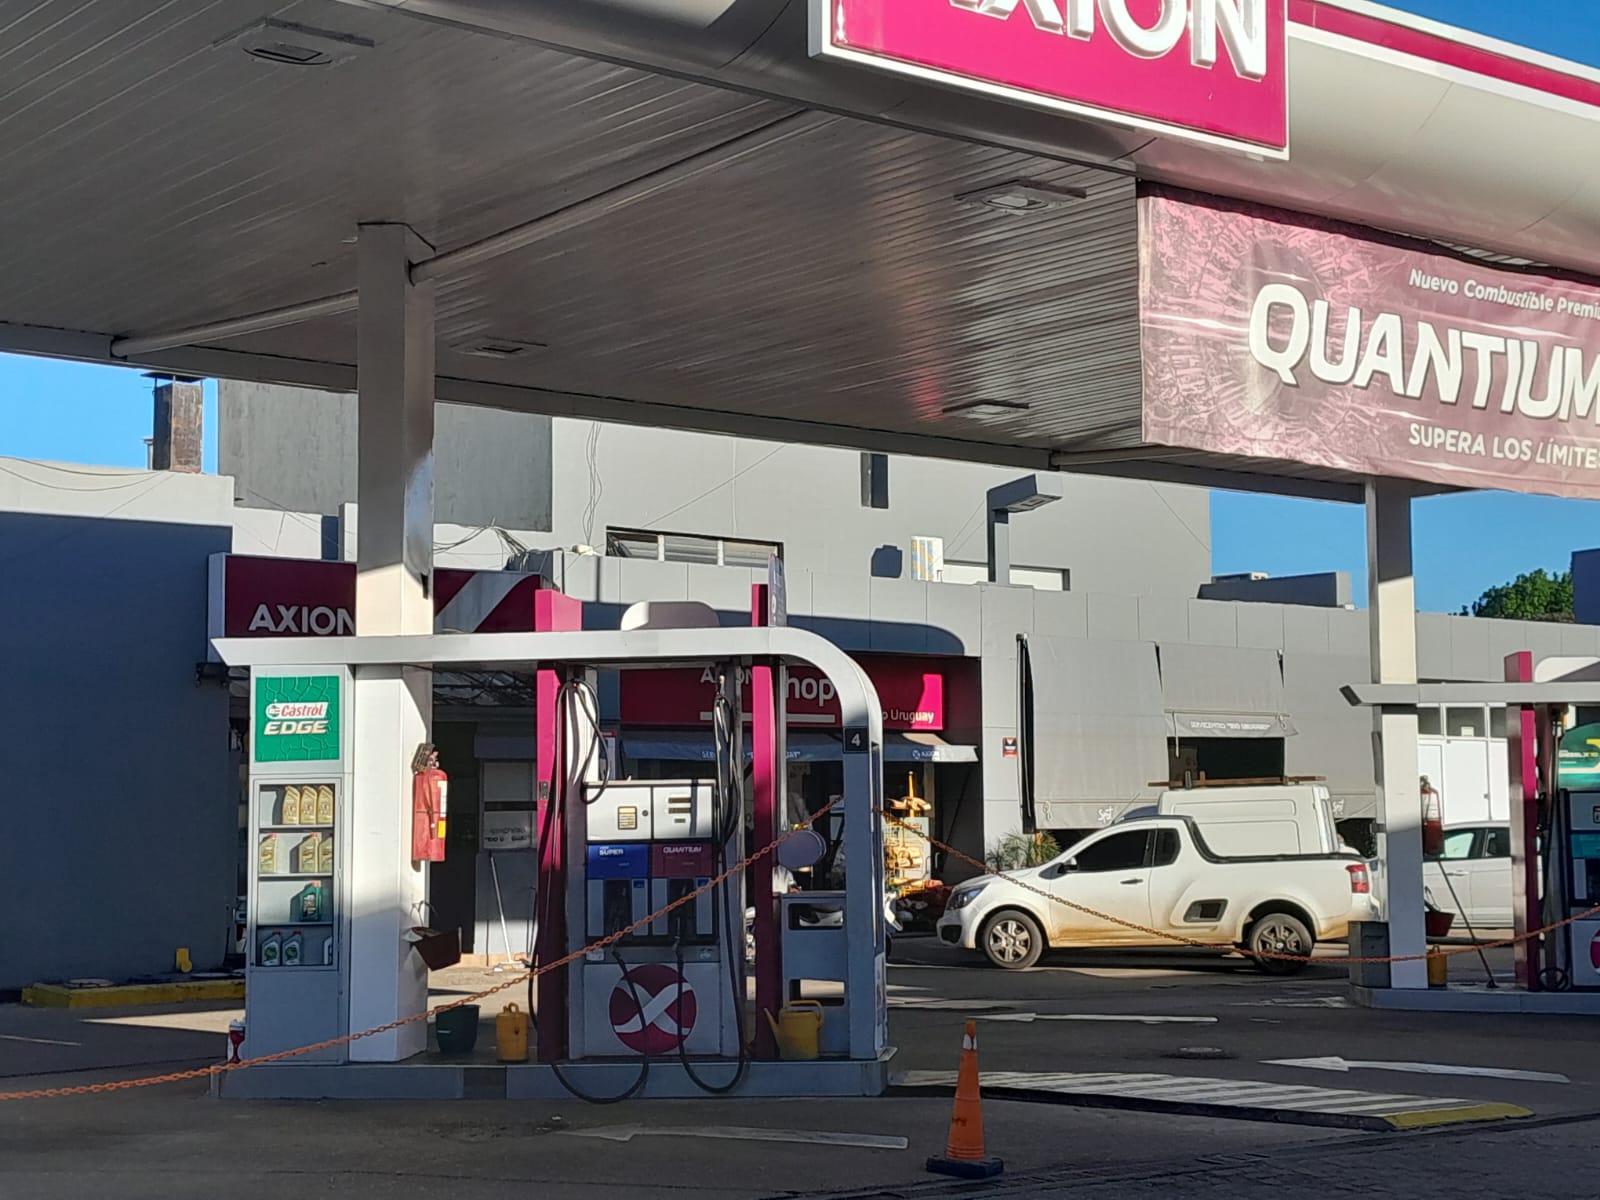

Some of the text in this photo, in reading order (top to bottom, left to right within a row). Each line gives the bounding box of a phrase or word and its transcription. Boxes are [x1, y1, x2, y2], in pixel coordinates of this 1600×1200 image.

[1409, 268, 1458, 295] Nuevo
[1464, 279, 1553, 311] Combustible
[1248, 283, 1600, 428] QUANTIUM
[1408, 423, 1600, 468] SUPERA LOS LÍMITE
[248, 604, 354, 635] AXION
[281, 704, 323, 717] Castrol
[890, 708, 935, 725] Uruguay
[263, 720, 329, 735] EDGE
[851, 733, 861, 747] 4
